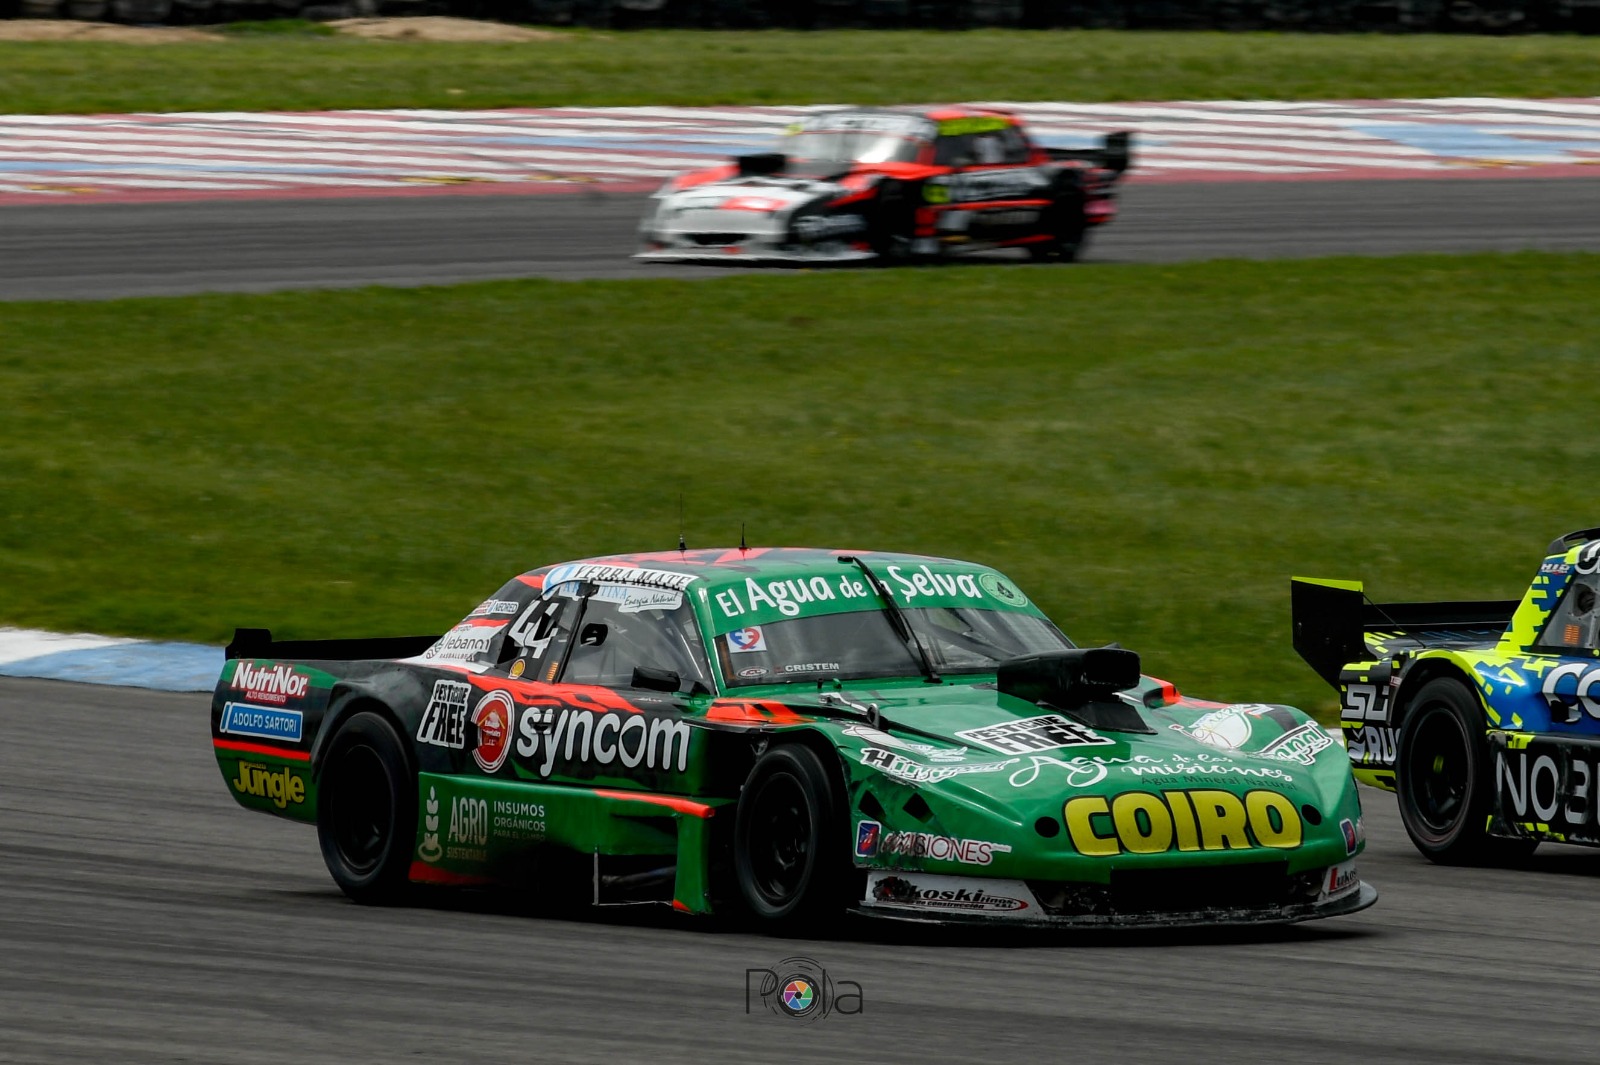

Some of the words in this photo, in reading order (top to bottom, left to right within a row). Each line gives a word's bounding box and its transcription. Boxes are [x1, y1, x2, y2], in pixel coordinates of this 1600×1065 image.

[563, 581, 628, 600] ARTINA
[746, 577, 836, 616] Agua
[839, 575, 868, 599] de
[886, 565, 983, 604] Selva
[784, 662, 840, 672] CRISTEM
[232, 712, 263, 728] ADOLFO
[264, 716, 297, 732] SARTORI
[420, 702, 466, 748] FREE
[516, 706, 691, 778] syncom
[982, 724, 1107, 752] FREE
[233, 760, 305, 809] Jungle
[1141, 775, 1182, 785] Agua
[1183, 775, 1240, 785] Mineral
[448, 796, 489, 846] AGRO
[493, 800, 545, 817] INSUMOS
[493, 816, 546, 832] ORGÁNICOS
[1062, 789, 1303, 859] COIRO
